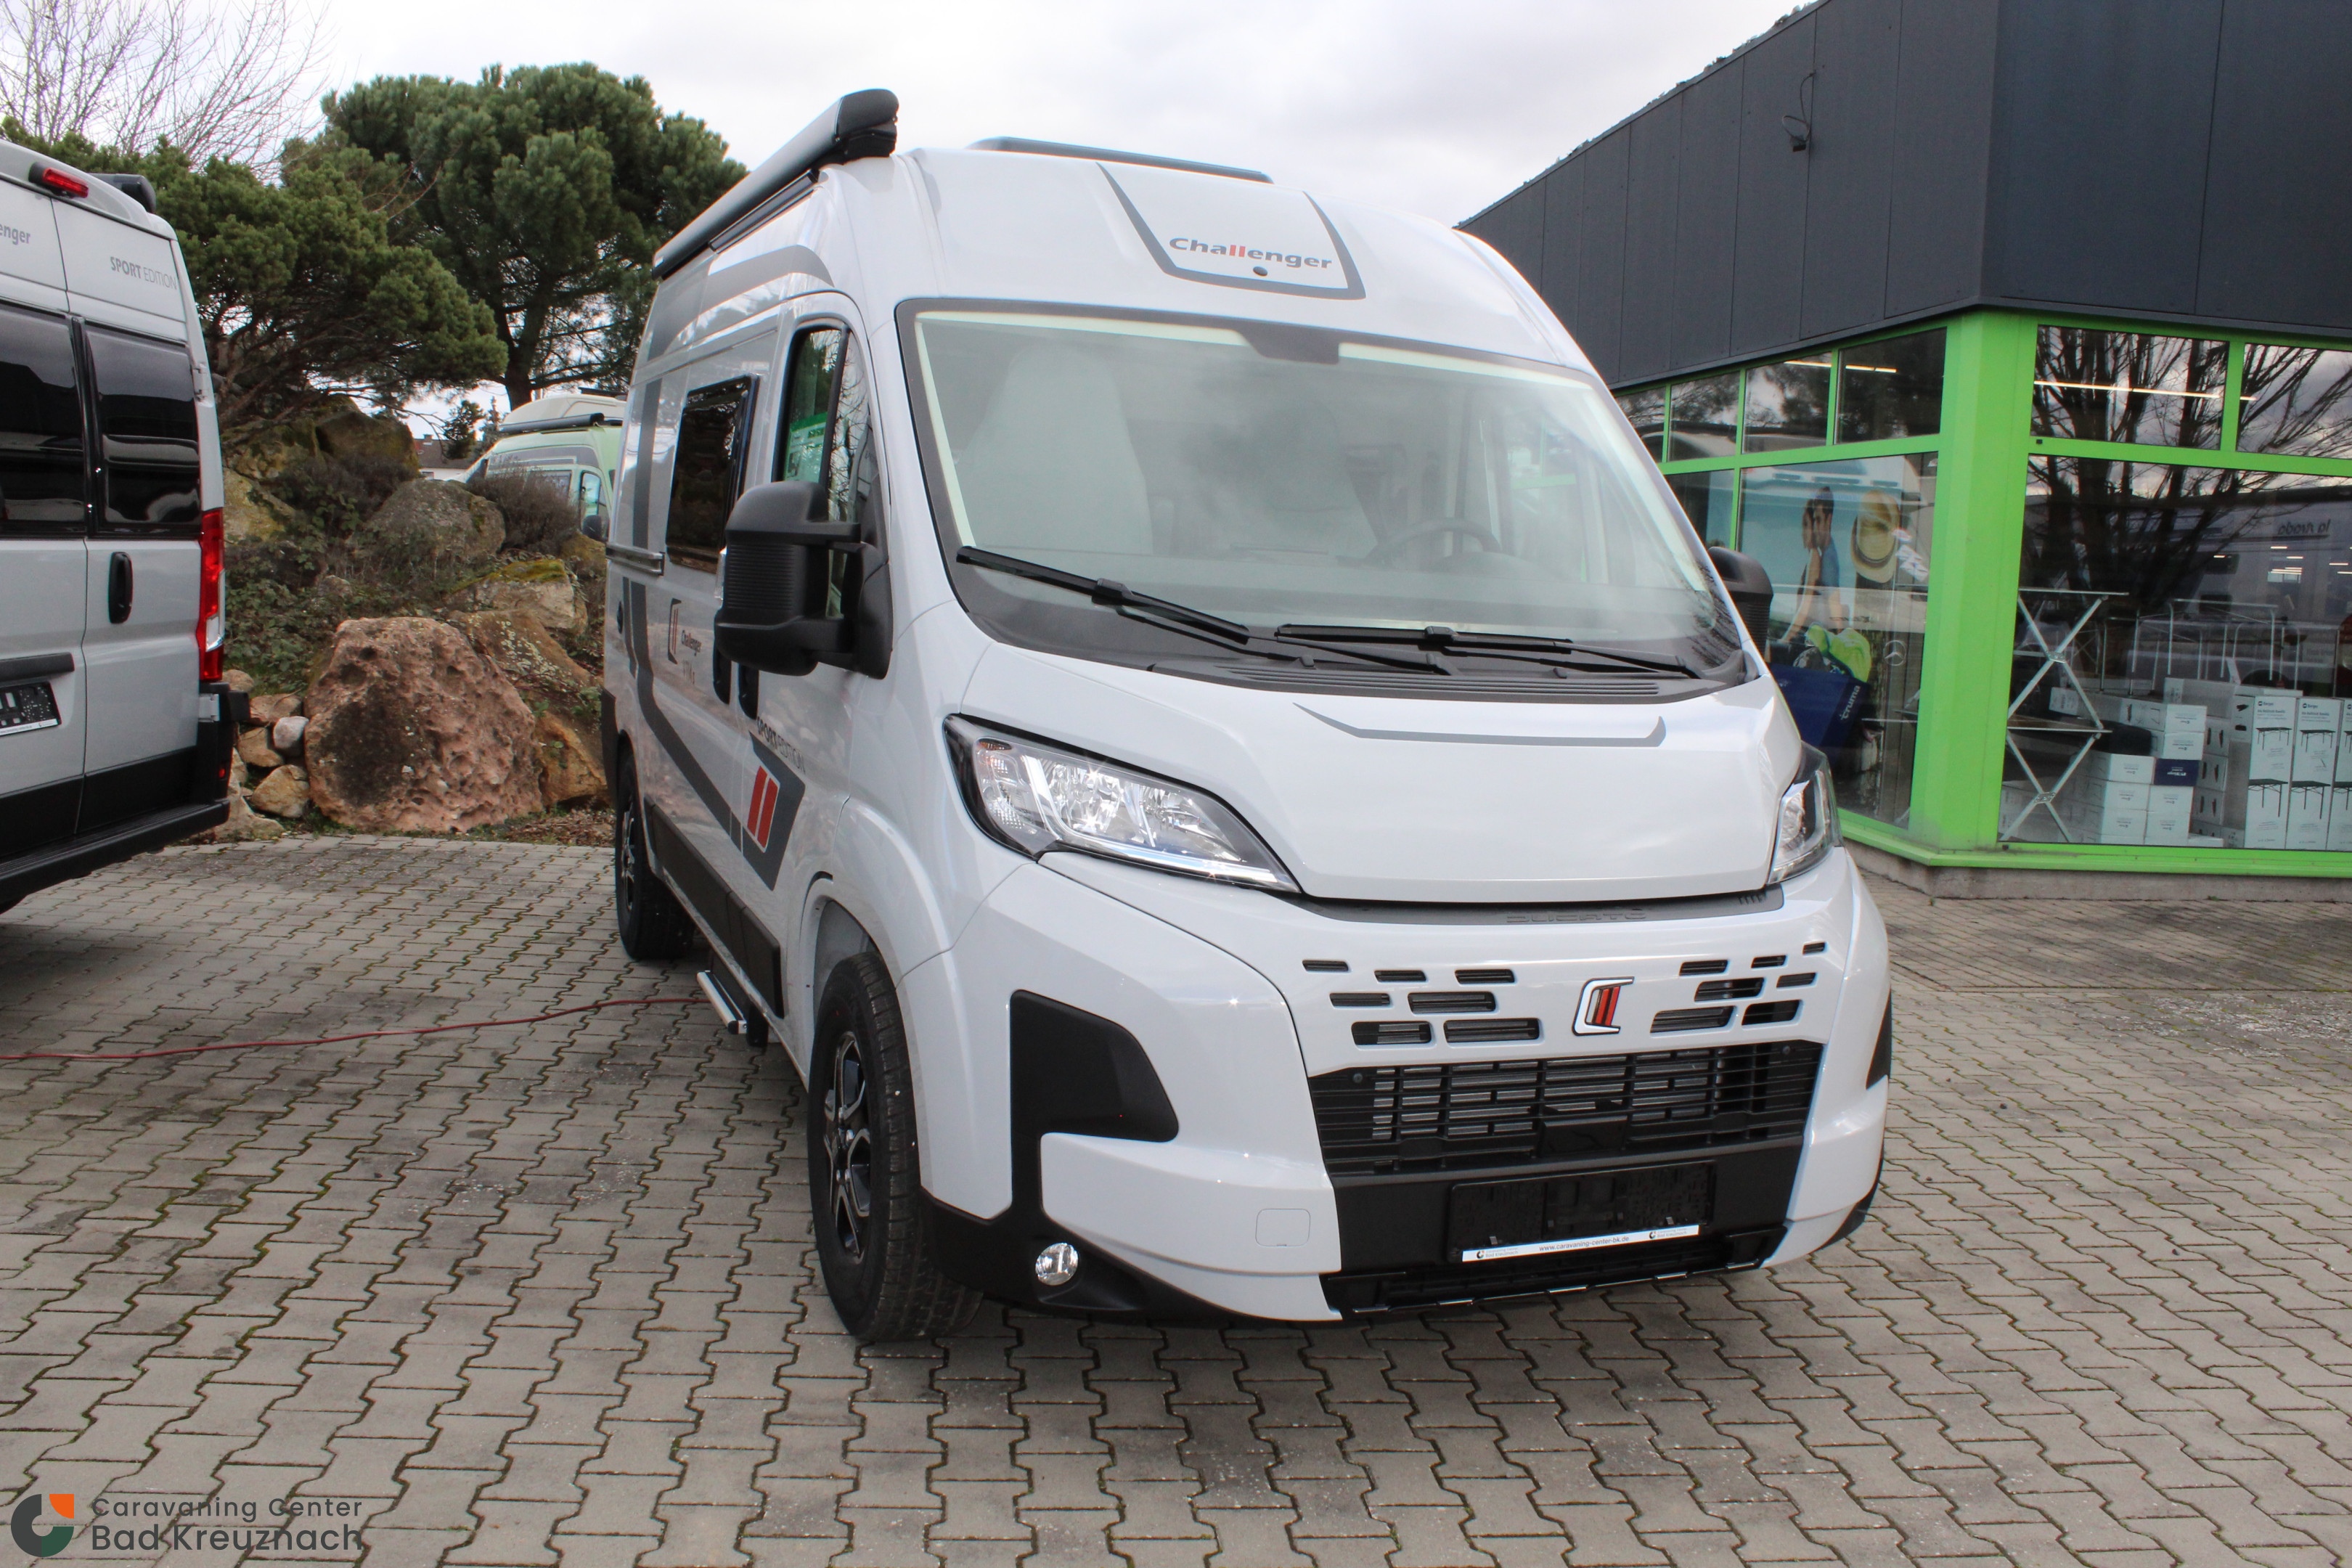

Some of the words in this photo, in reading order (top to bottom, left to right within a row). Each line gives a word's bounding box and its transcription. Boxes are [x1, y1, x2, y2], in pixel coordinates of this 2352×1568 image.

[1169, 237, 1332, 269] Challenger
[110, 256, 142, 279] SPORT
[143, 266, 177, 290] EDITION
[757, 716, 777, 750] SPORT
[777, 734, 806, 774] EDITION
[1506, 908, 1646, 923] DUCATO
[1539, 1236, 1630, 1252] www.caravaning-center-bk.de
